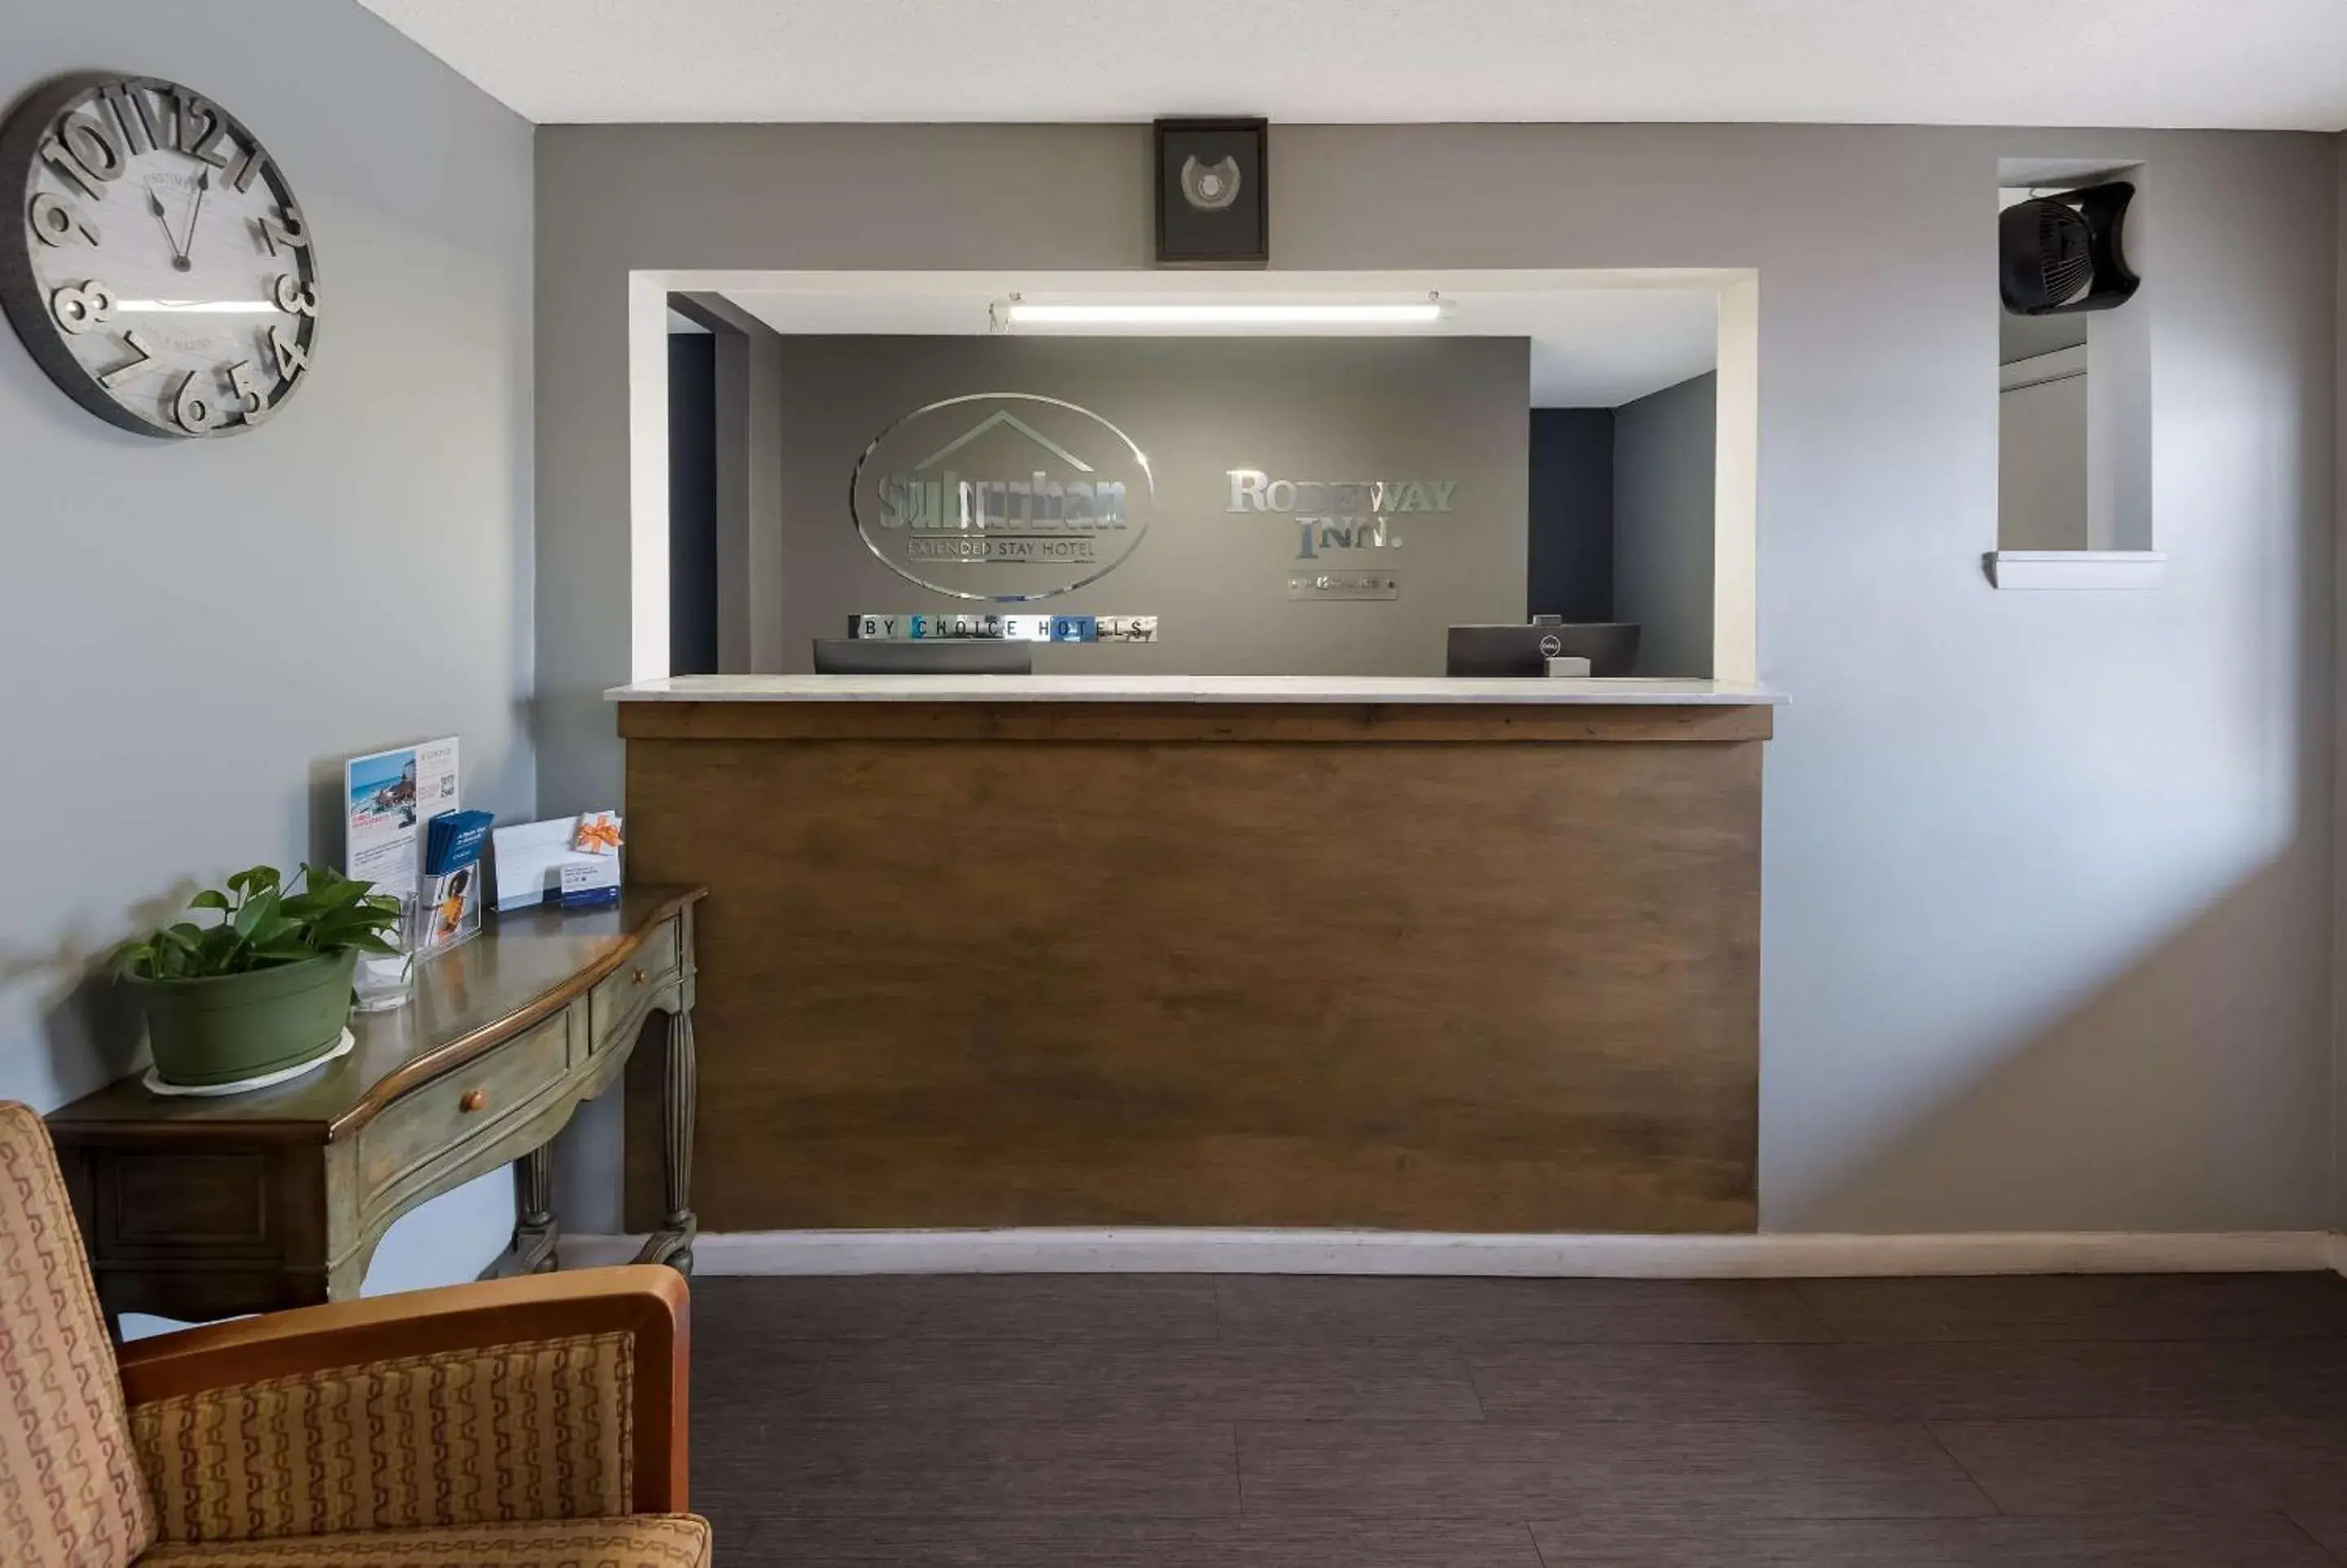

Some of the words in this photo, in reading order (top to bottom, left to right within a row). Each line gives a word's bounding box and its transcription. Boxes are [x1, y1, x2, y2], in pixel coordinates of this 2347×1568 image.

[163, 83, 228, 170] 12
[38, 109, 127, 202] 10
[29, 191, 99, 248] 9
[256, 205, 308, 258] 2
[51, 278, 116, 335] 8
[274, 272, 319, 317] 3
[96, 330, 153, 389] 7
[266, 325, 308, 381] 4
[173, 370, 211, 433] 6
[226, 359, 268, 425] 5
[906, 541, 991, 556] EXTENDED
[998, 541, 1035, 556] STAY
[1042, 541, 1095, 556] HOTEL
[865, 620, 895, 635] BY
[918, 620, 1017, 636] CHOICE
[1038, 620, 1143, 636] HOTELS
